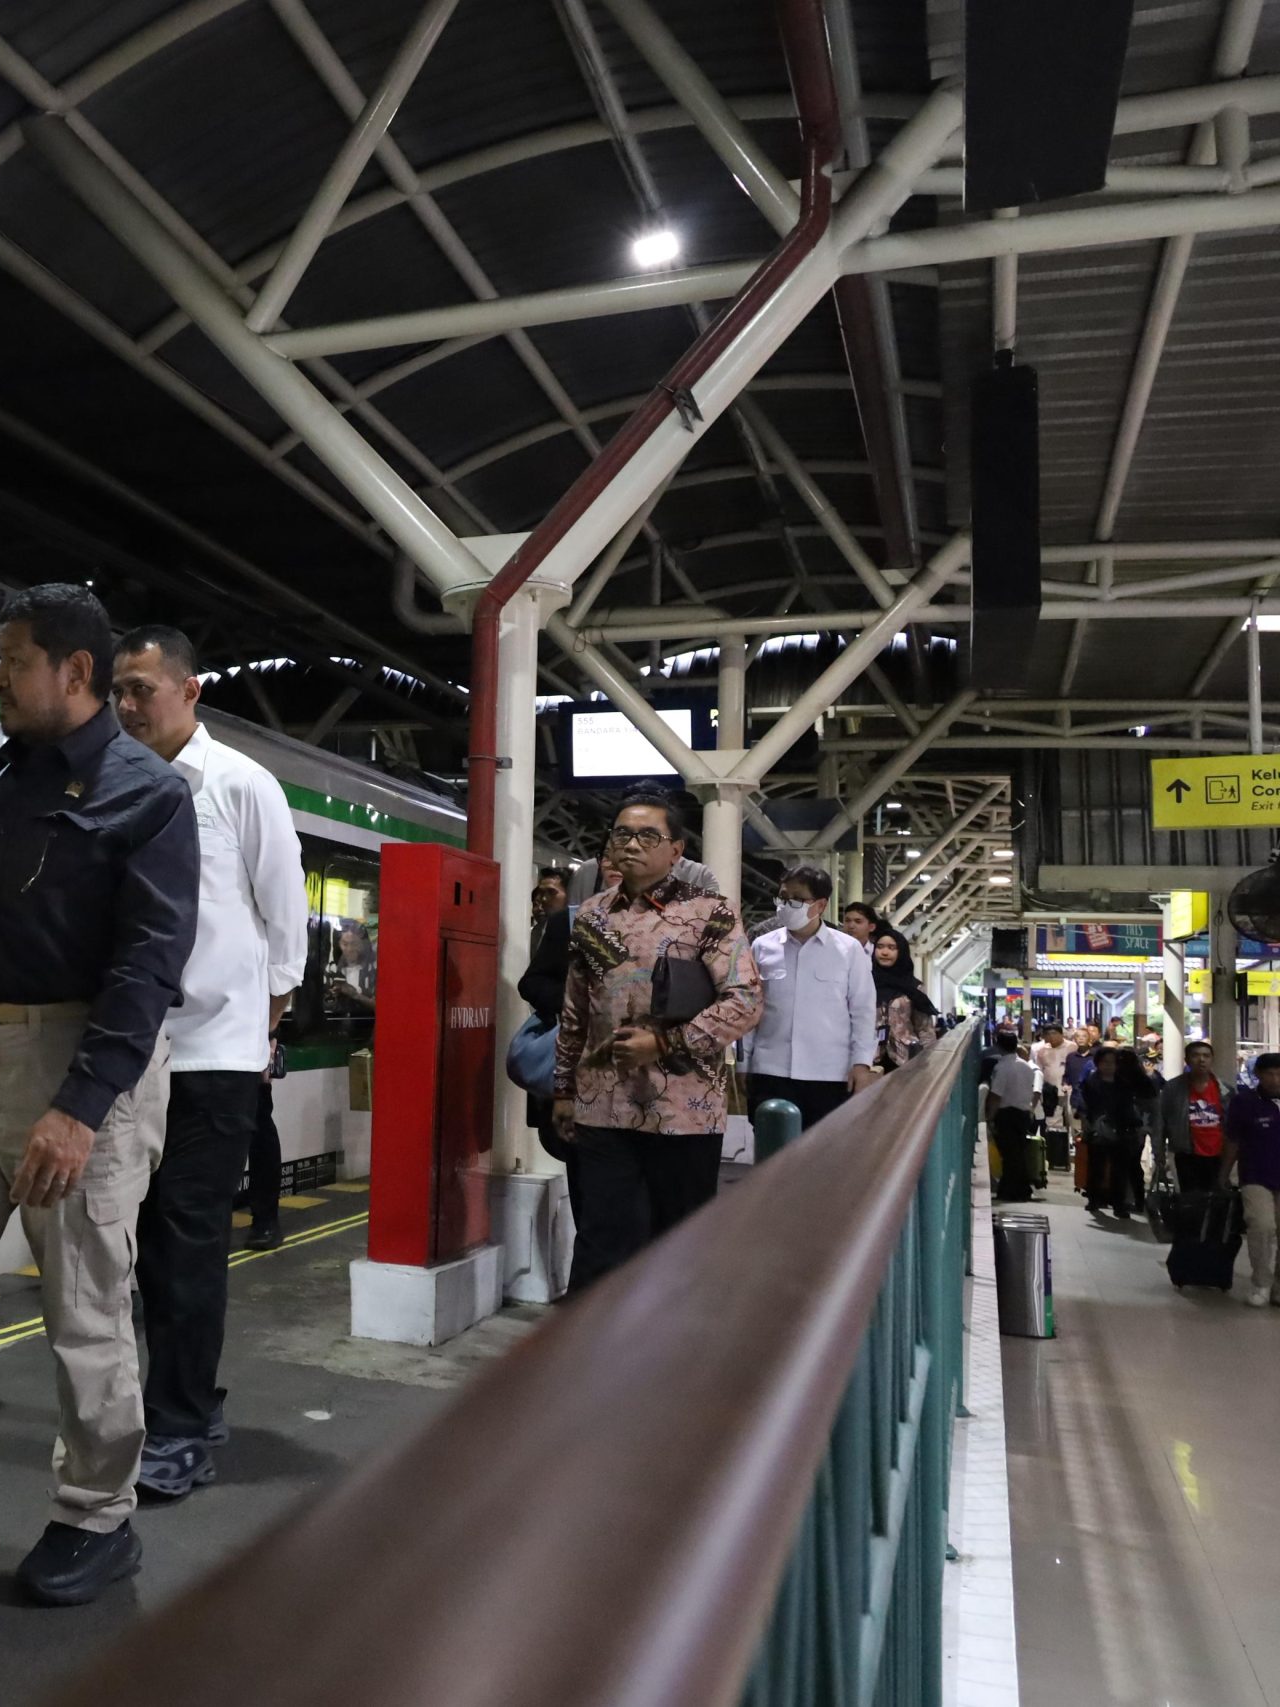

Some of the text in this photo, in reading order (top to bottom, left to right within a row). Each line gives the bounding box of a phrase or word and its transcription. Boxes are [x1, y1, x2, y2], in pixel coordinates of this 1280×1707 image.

[1251, 801, 1274, 811] Exit
[1125, 938, 1150, 950] SPACE
[450, 1007, 490, 1029] HYDRANT
